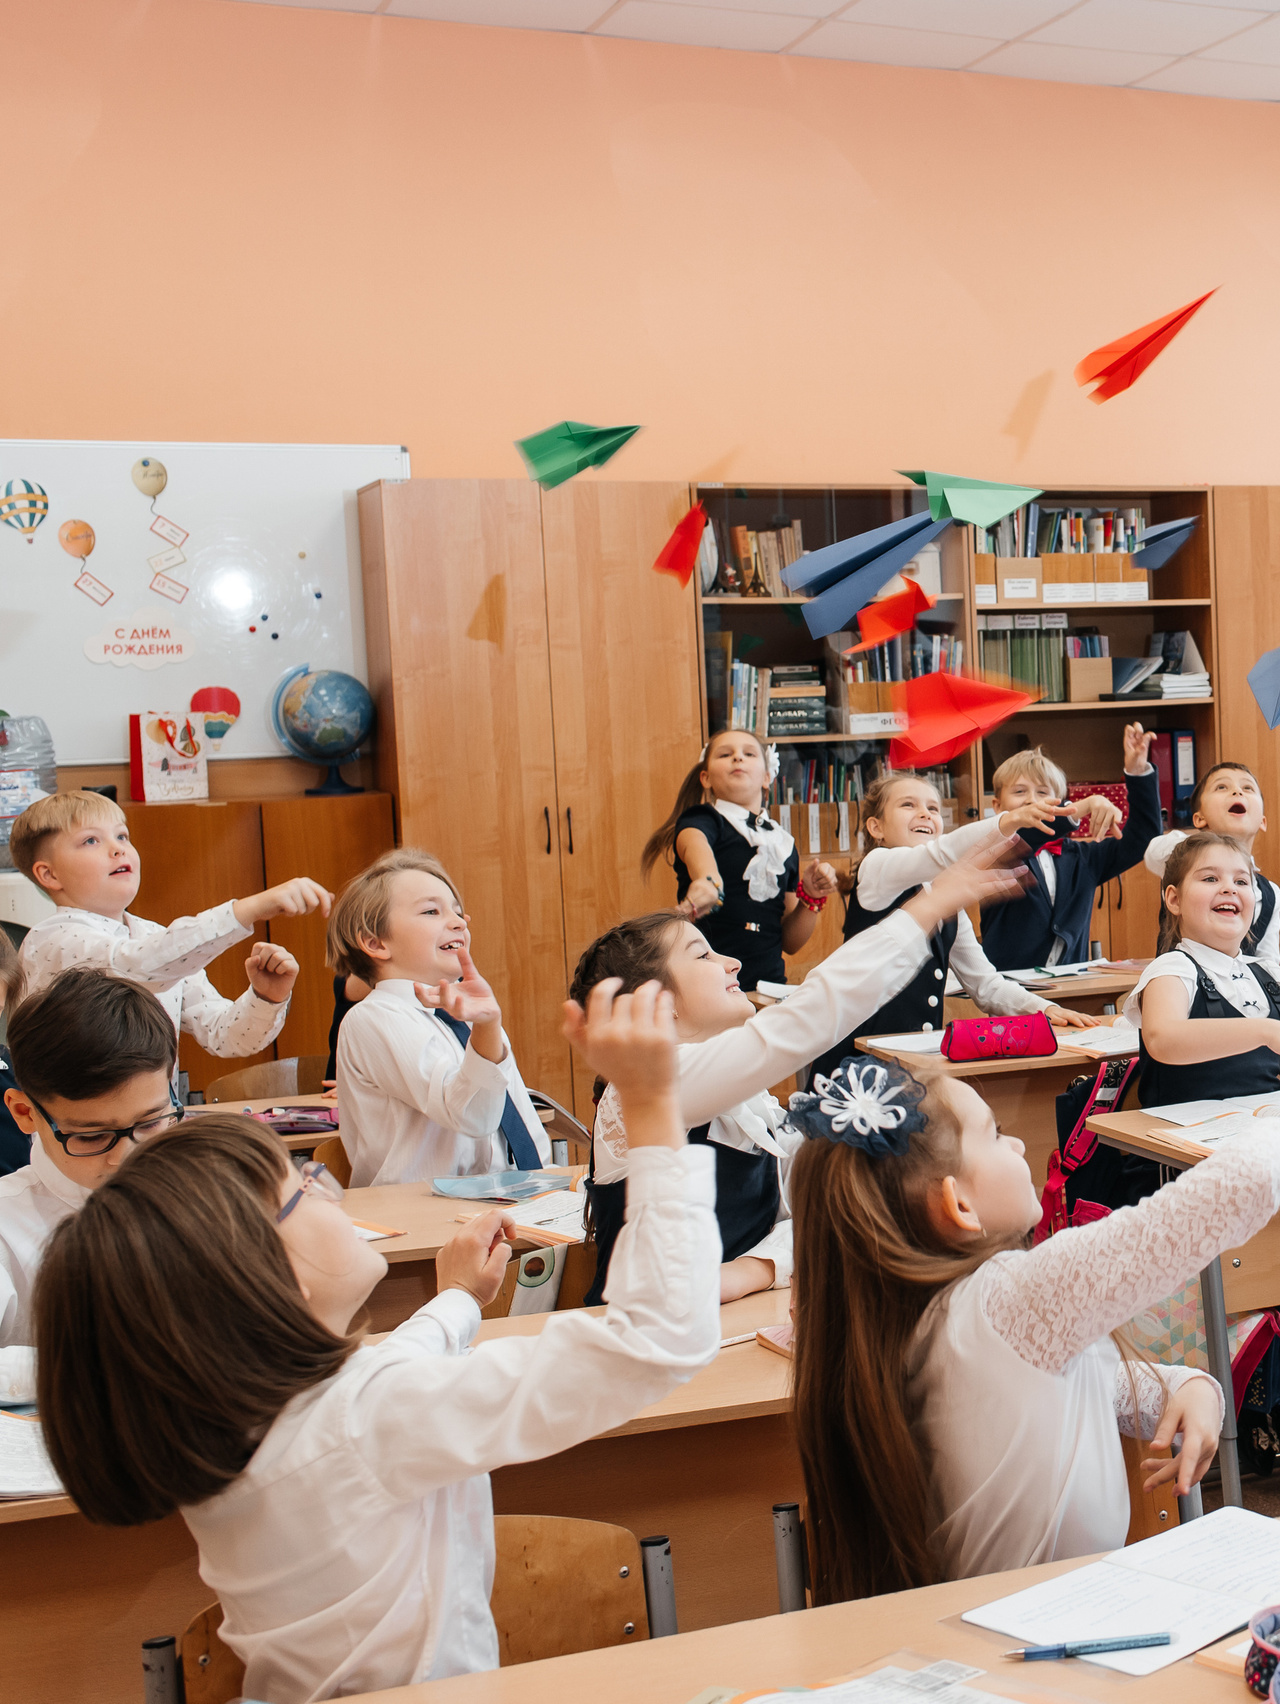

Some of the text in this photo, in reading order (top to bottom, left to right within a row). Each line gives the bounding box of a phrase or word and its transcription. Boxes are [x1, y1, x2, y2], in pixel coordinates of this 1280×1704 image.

[114, 626, 172, 640] С ДНЁМ
[103, 644, 183, 655] РОЖДЕНИЯ
